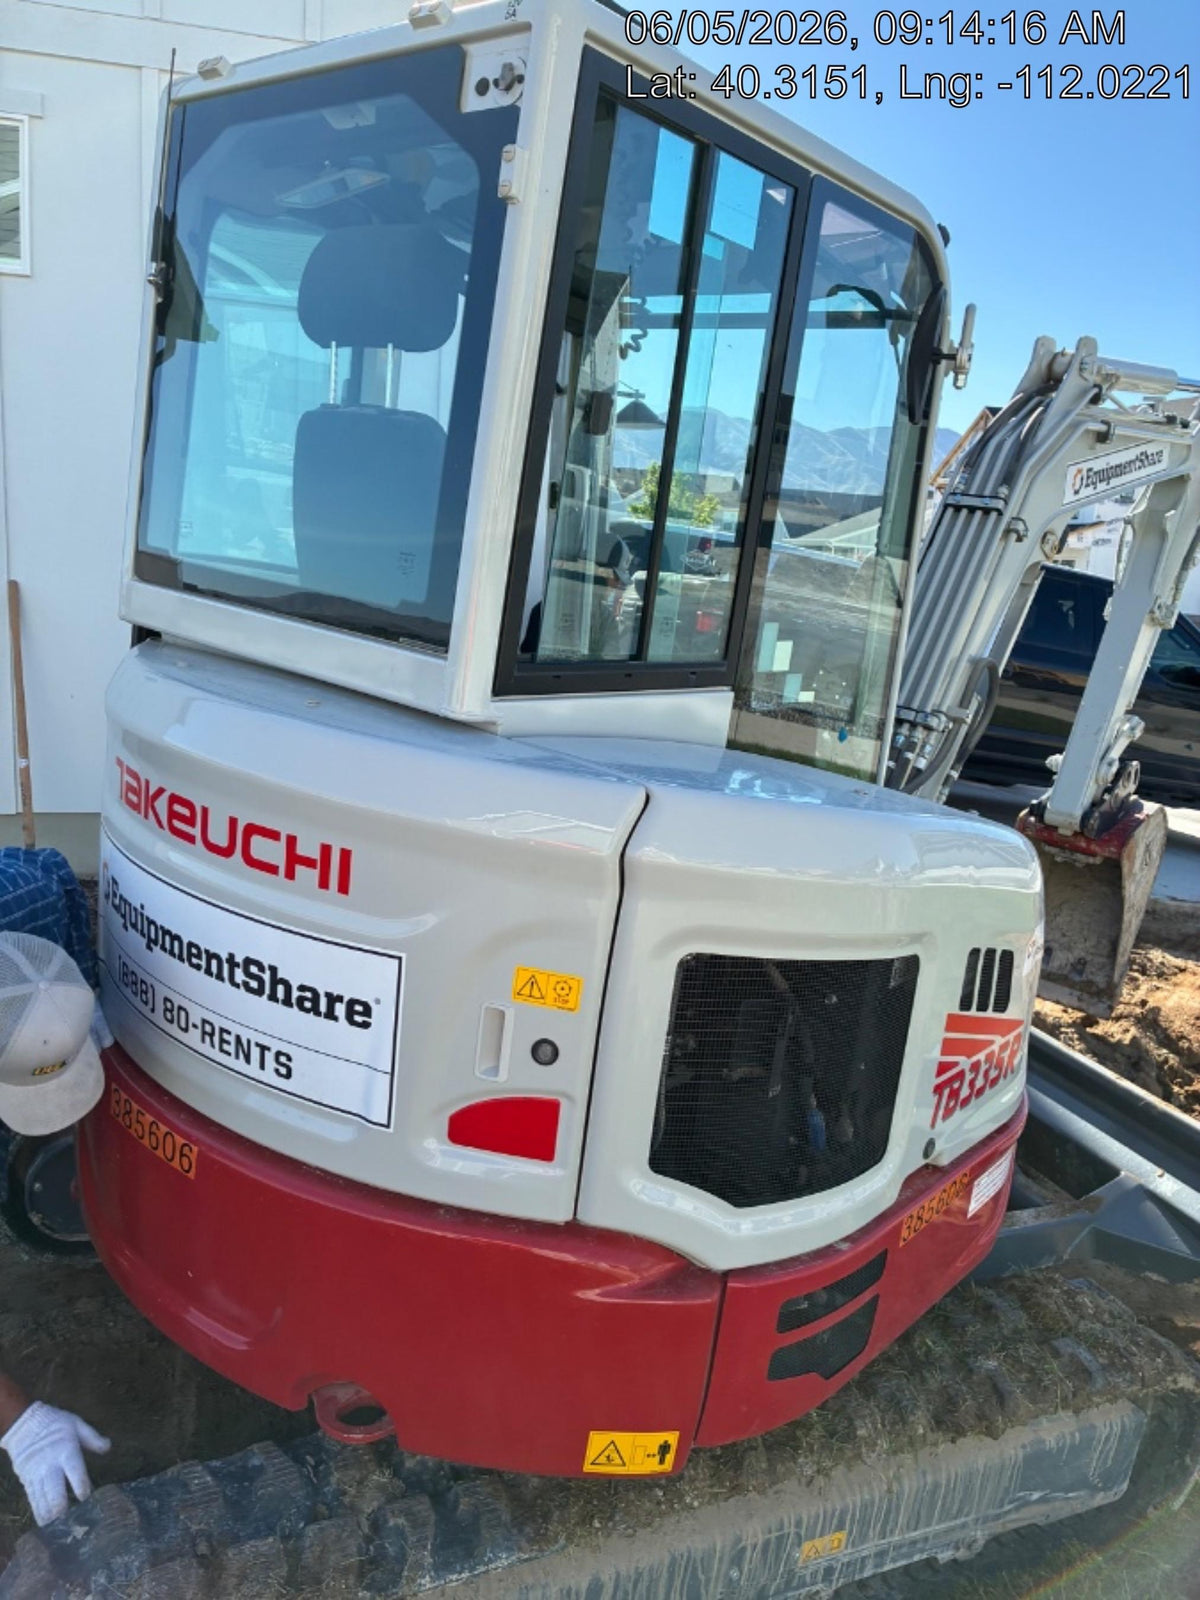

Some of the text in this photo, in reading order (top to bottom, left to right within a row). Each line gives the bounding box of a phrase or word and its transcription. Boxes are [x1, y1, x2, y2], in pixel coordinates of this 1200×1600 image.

[116, 756, 352, 896] TAKEUCHI
[111, 875, 373, 1030] EquipmentShare
[118, 954, 293, 1081] (888) 80-RENTS
[112, 1087, 193, 1174] 385606
